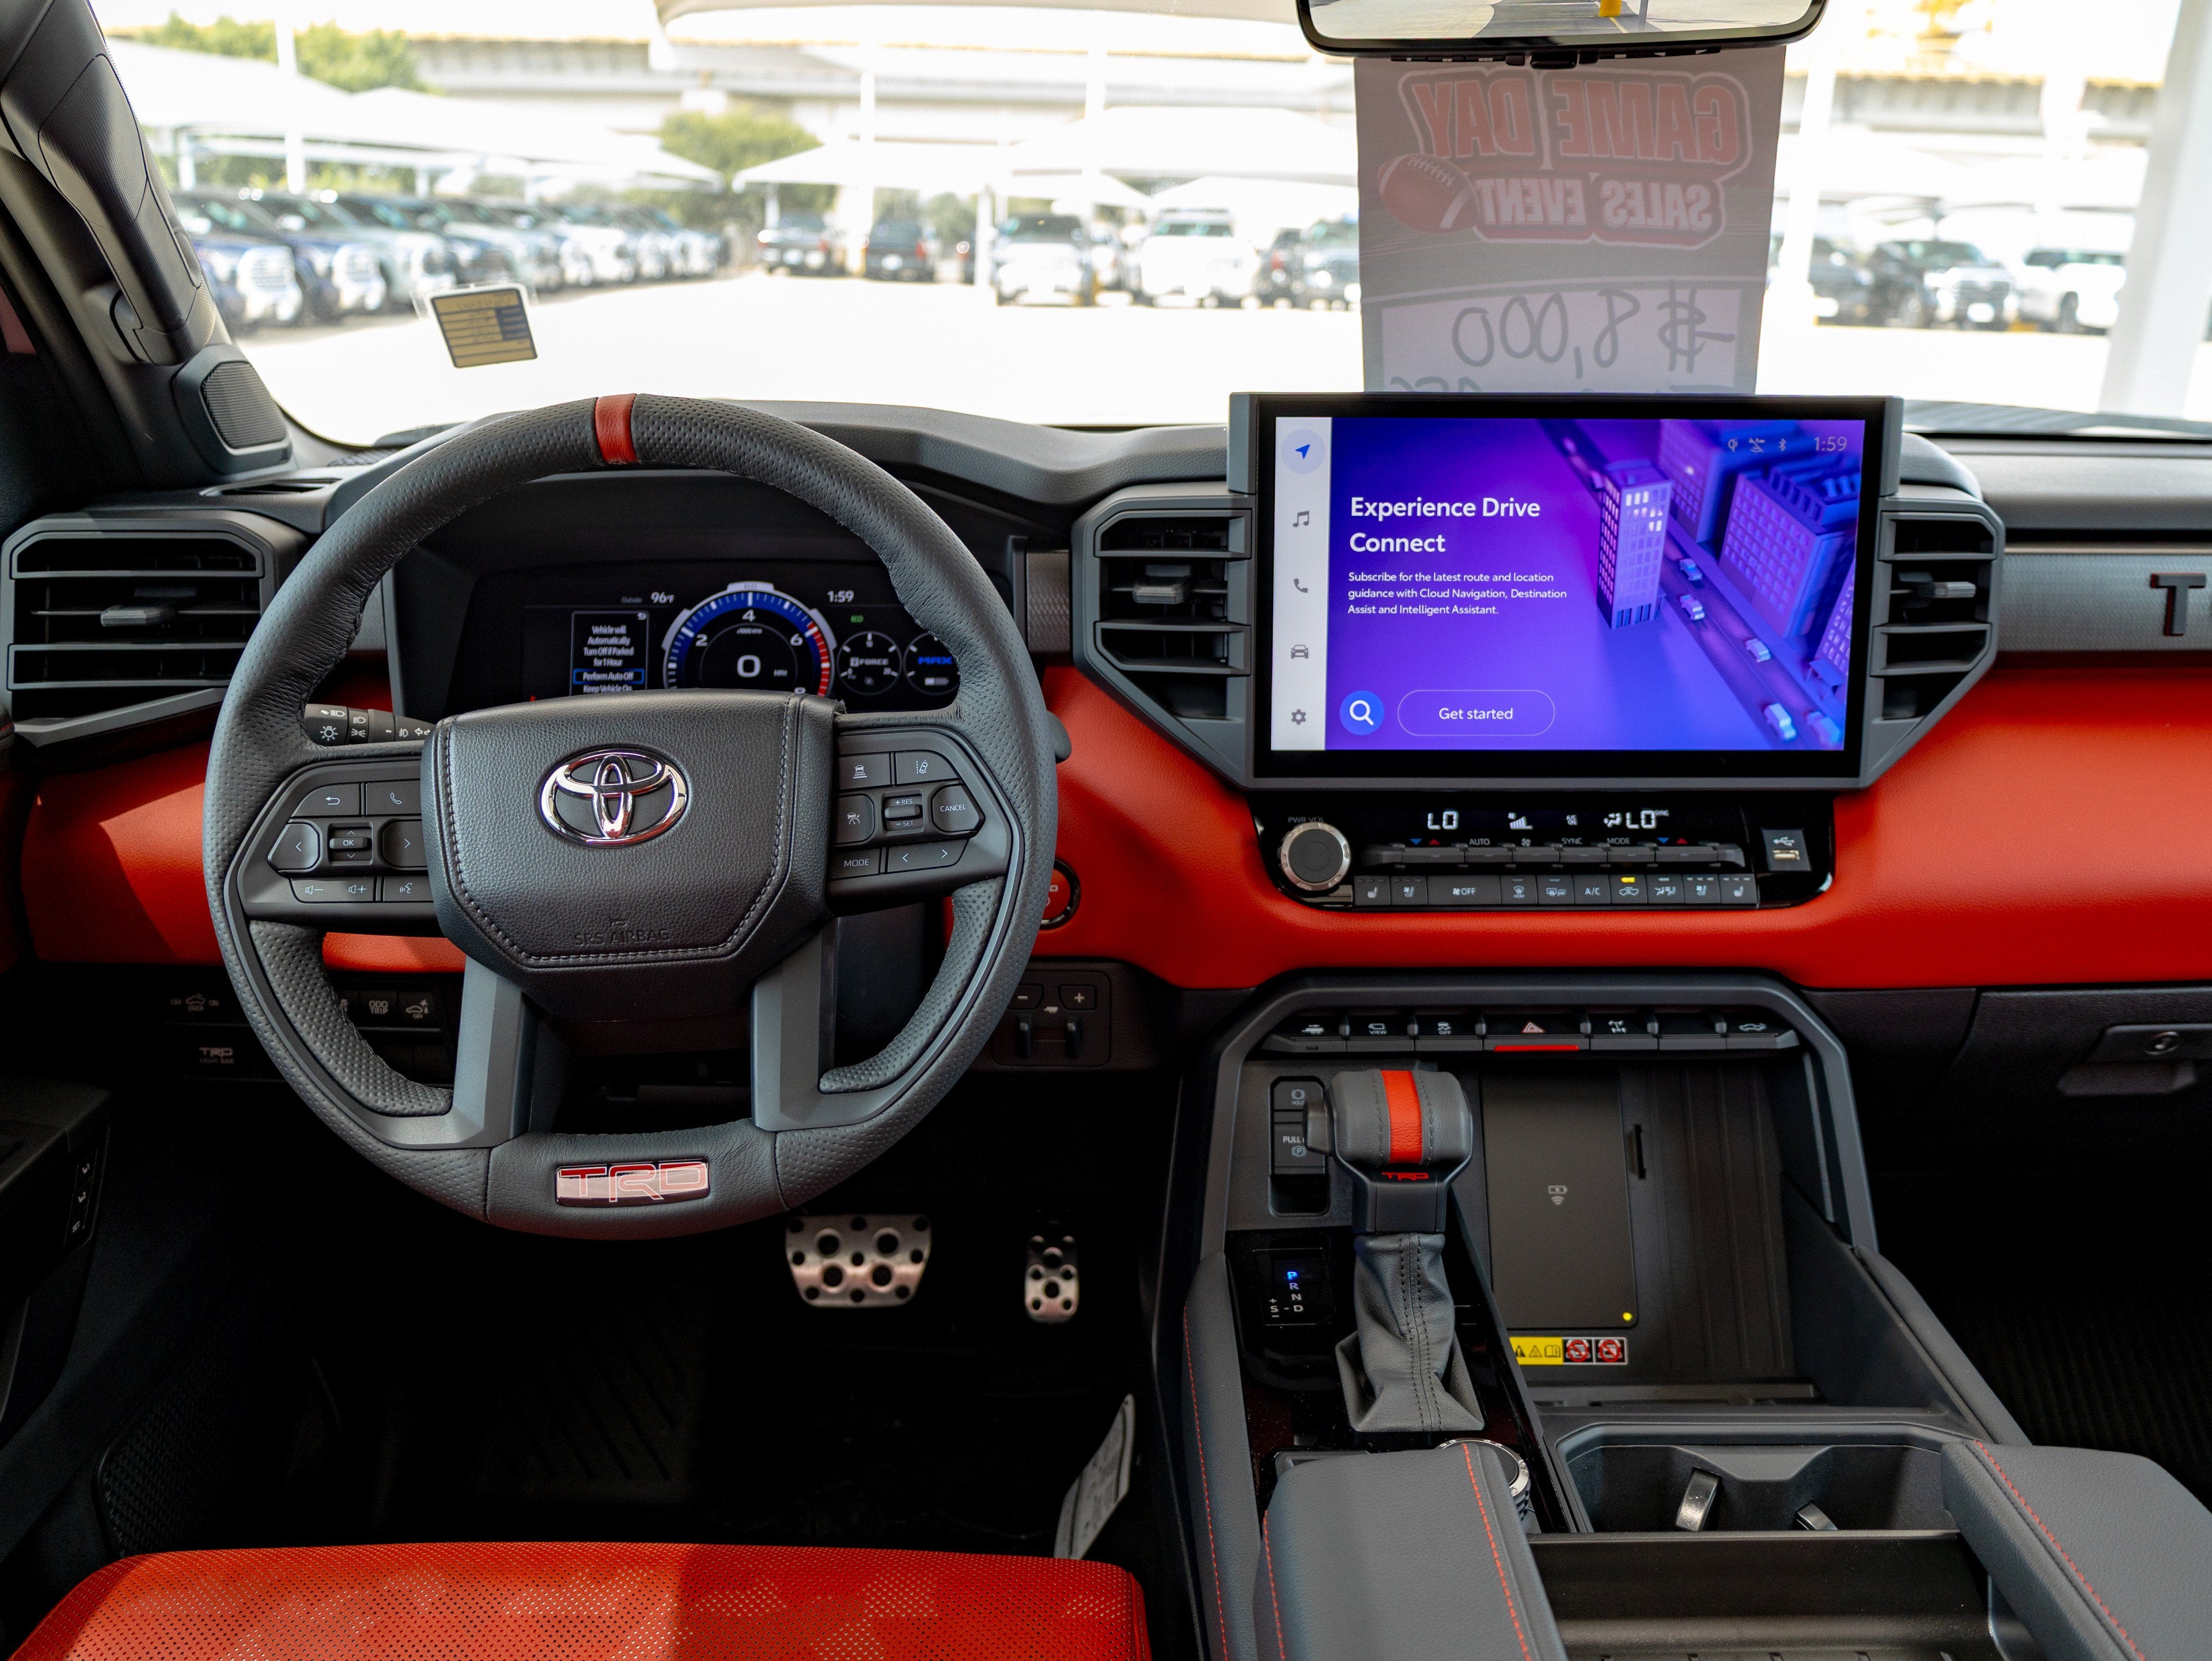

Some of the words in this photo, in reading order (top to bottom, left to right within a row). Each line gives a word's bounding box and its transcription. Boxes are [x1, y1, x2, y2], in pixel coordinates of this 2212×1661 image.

[1814, 436, 1847, 452] 1:59
[1351, 497, 1476, 522] Experience
[1482, 497, 1540, 517] Drive
[1349, 532, 1446, 553] Connect
[1348, 572, 1397, 582] Subscribe
[1399, 572, 1413, 582] for
[1415, 572, 1431, 582] the
[1433, 572, 1461, 582] latest
[1463, 573, 1490, 582] route
[1492, 573, 1512, 582] and
[1513, 573, 1554, 582] location
[827, 590, 854, 603] 1:59
[1348, 589, 1395, 600] guidance
[1396, 588, 1418, 598] with
[1419, 588, 1450, 598] Cloud
[1452, 589, 1508, 599] Navigation,
[1510, 589, 1567, 598] Destination
[1347, 605, 1376, 614] Assist
[1378, 605, 1397, 614] and
[1399, 604, 1450, 616] Intelligent
[1452, 605, 1499, 615] Assistant.
[742, 609, 756, 622] 4
[592, 625, 614, 634] Vehicle
[614, 625, 627, 634] will
[588, 636, 631, 646] Automatically
[695, 634, 708, 646] 2
[790, 633, 804, 646] 6
[584, 647, 597, 656] Turn
[597, 647, 608, 656] Off
[608, 647, 612, 656] if
[612, 646, 634, 656] Parked
[593, 657, 602, 667] for
[603, 658, 607, 667] 1
[607, 658, 623, 667] Hour
[918, 656, 953, 665] MAX
[737, 654, 761, 678] 0
[583, 672, 608, 681] Perform
[608, 672, 623, 680] Auto
[623, 672, 634, 680] Off
[583, 685, 600, 693] Keep
[600, 684, 622, 693] Vehicle
[1439, 707, 1463, 720] Get
[1467, 707, 1513, 720] started
[940, 804, 967, 812] CANCEL
[1427, 810, 1459, 830] LO
[1625, 810, 1657, 830] LO
[1469, 838, 1490, 846] AUTO
[1562, 837, 1582, 845] SYNC
[1607, 837, 1630, 845] MODE
[844, 858, 869, 867] MODE
[1461, 887, 1476, 895] OFF
[1585, 887, 1600, 895] A/C
[574, 930, 604, 945] SRS
[608, 928, 671, 945] AIRBAG
[198, 1047, 234, 1057] TRD
[559, 1161, 709, 1202] TRD
[1381, 1172, 1429, 1181] TRD
[1287, 1271, 1298, 1281] P
[1270, 1305, 1279, 1313] S
[1293, 1304, 1304, 1312] D
